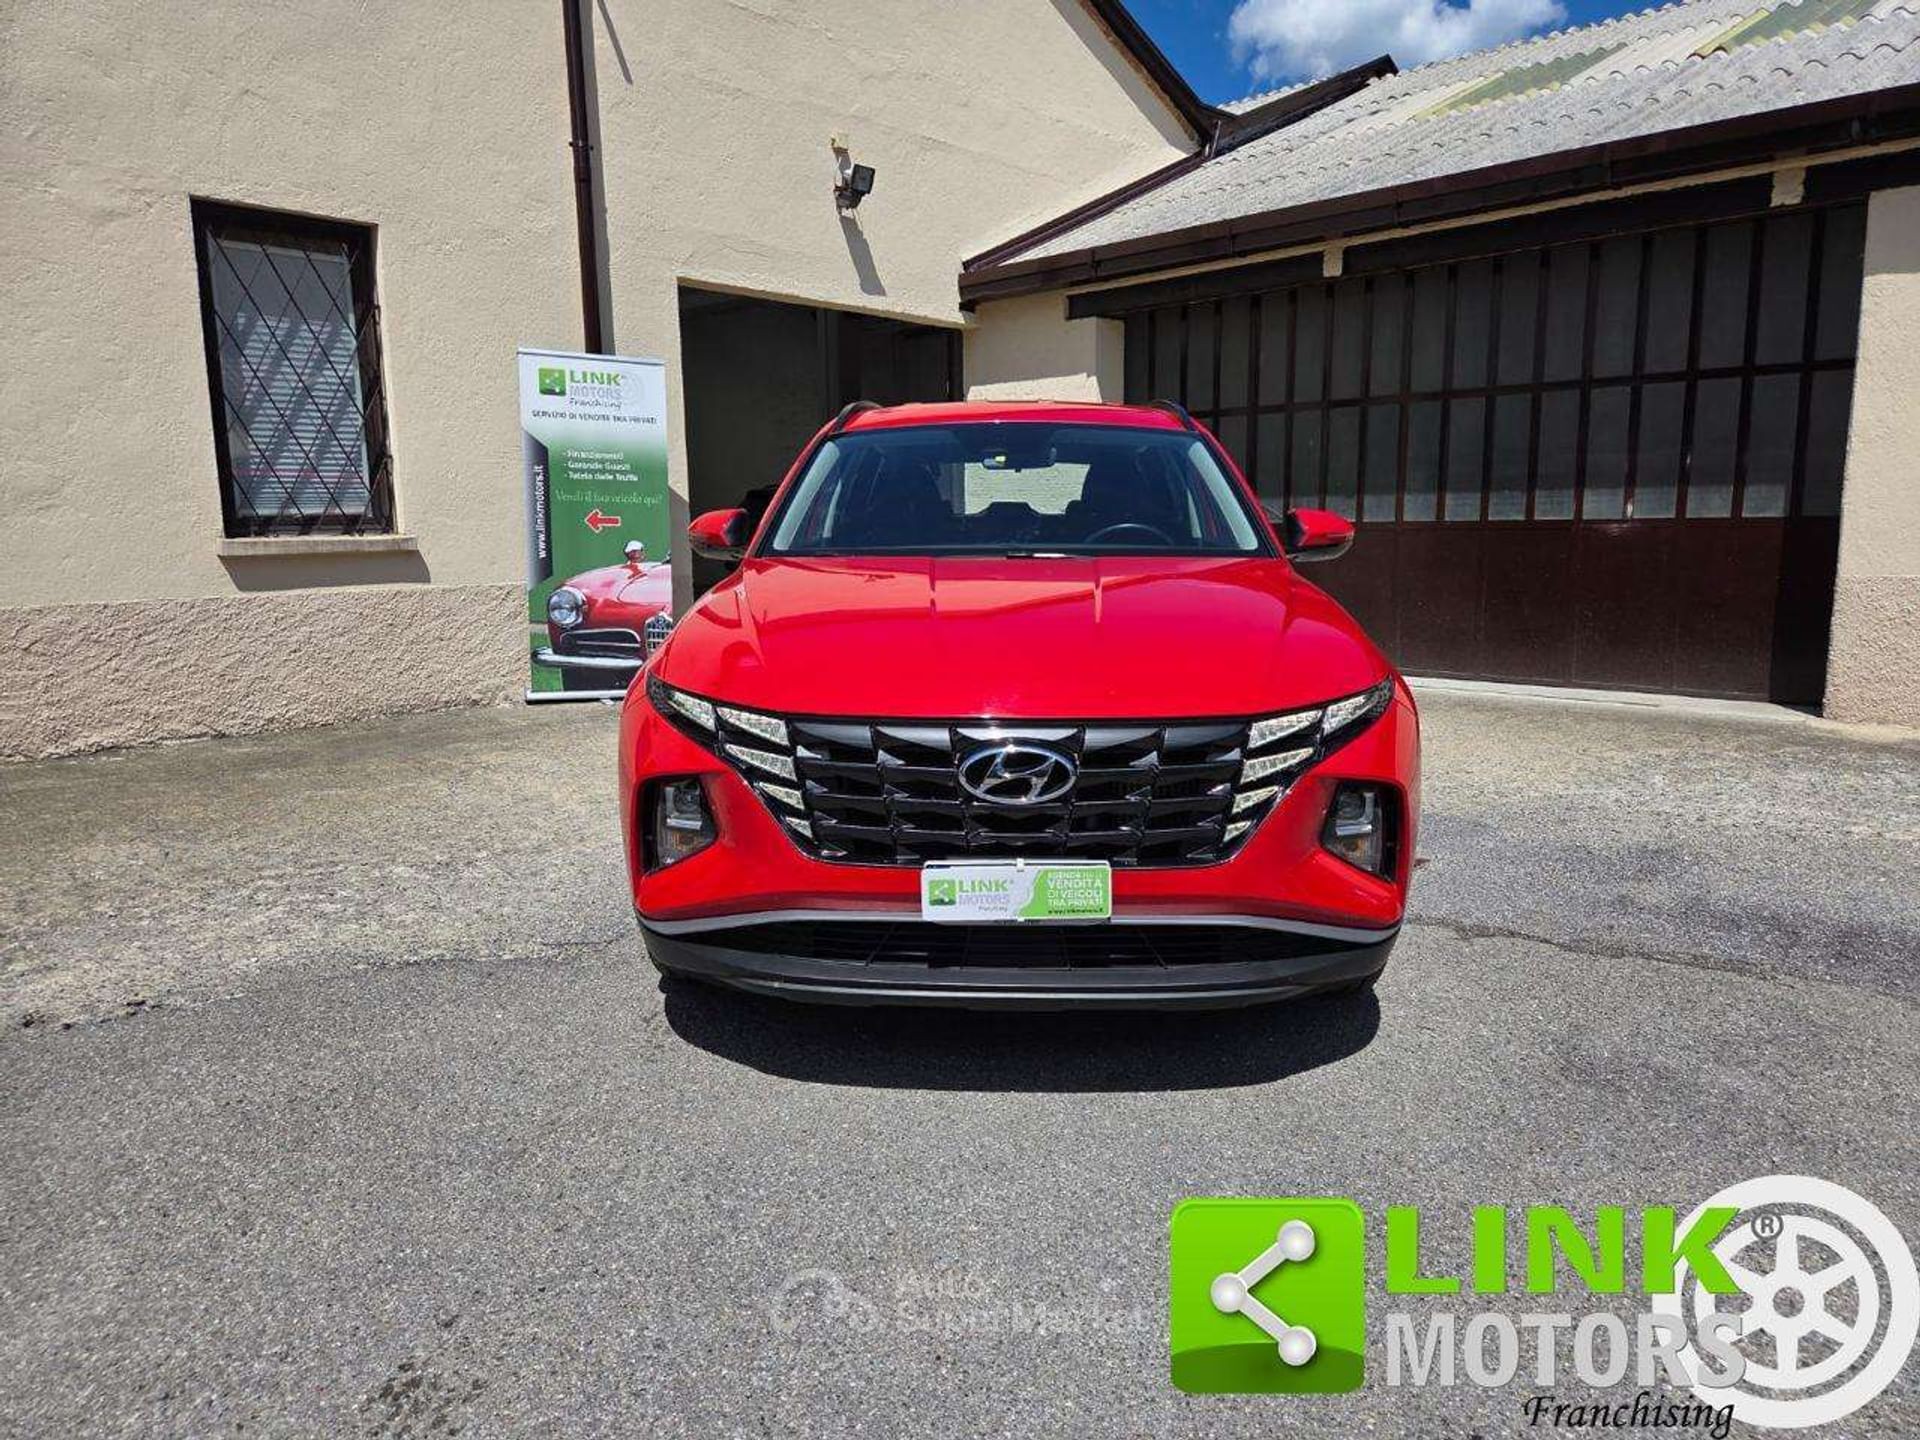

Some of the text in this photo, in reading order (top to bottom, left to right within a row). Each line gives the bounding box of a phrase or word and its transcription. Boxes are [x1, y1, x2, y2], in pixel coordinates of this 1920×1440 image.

[570, 370, 621, 386] LINK
[570, 386, 622, 400] MOTORS
[959, 879, 1009, 893] LINK
[1047, 879, 1102, 889] VENDITA
[959, 894, 1009, 905] MOTORS
